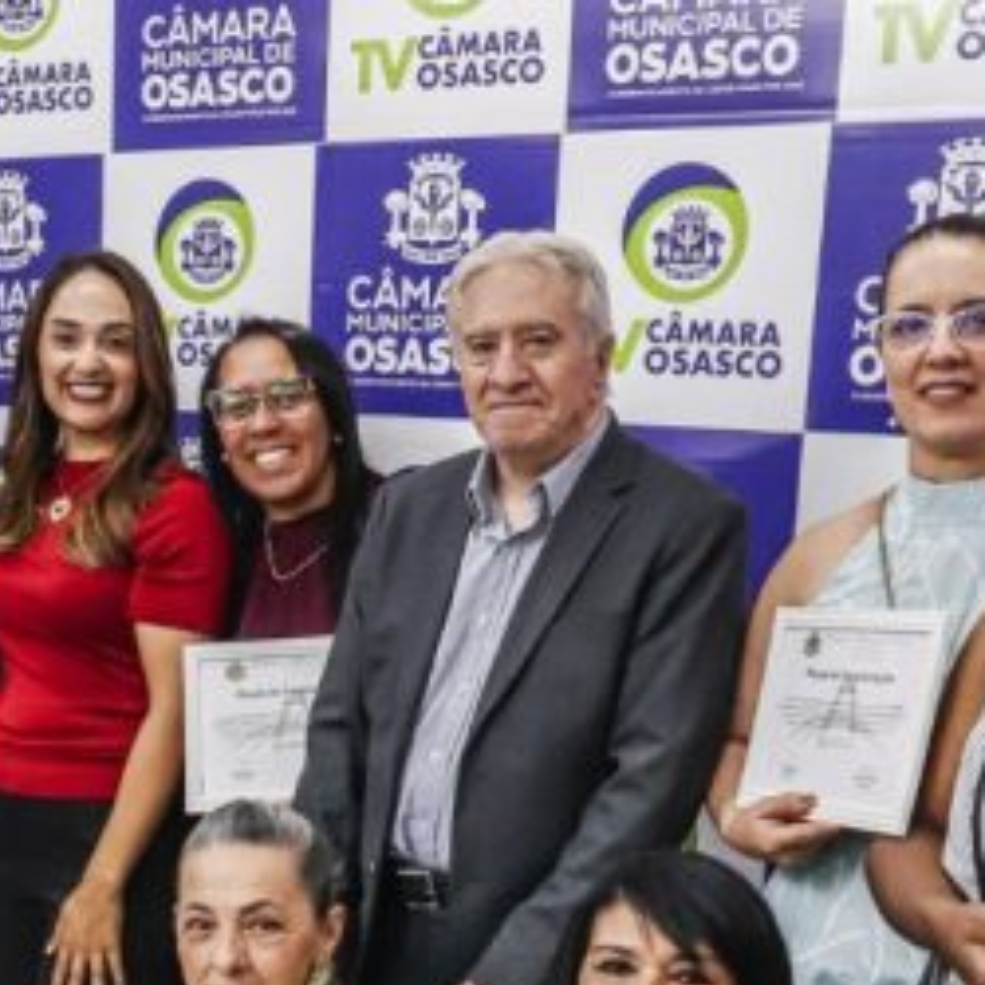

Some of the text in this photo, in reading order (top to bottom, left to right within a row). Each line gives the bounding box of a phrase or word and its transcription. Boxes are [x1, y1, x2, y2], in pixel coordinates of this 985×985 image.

[142, 4, 296, 48] CÂMARA
[607, 8, 804, 41] MUNICIPAL DE
[874, 0, 956, 64] TV
[141, 41, 296, 72] MUNICIPAL DE
[417, 27, 542, 60] CÂMARA
[606, 34, 800, 84] OSASCO
[350, 36, 417, 95] TV
[417, 57, 544, 90] OSASCO
[142, 66, 294, 109] OSASCO
[347, 267, 450, 308] CÂMA
[179, 310, 232, 339] CÂM
[346, 312, 449, 332] MUNICIP
[646, 311, 781, 347] CÂMARA
[346, 336, 452, 374] OSAS
[612, 318, 648, 371] V
[645, 347, 782, 379] OSASCO
